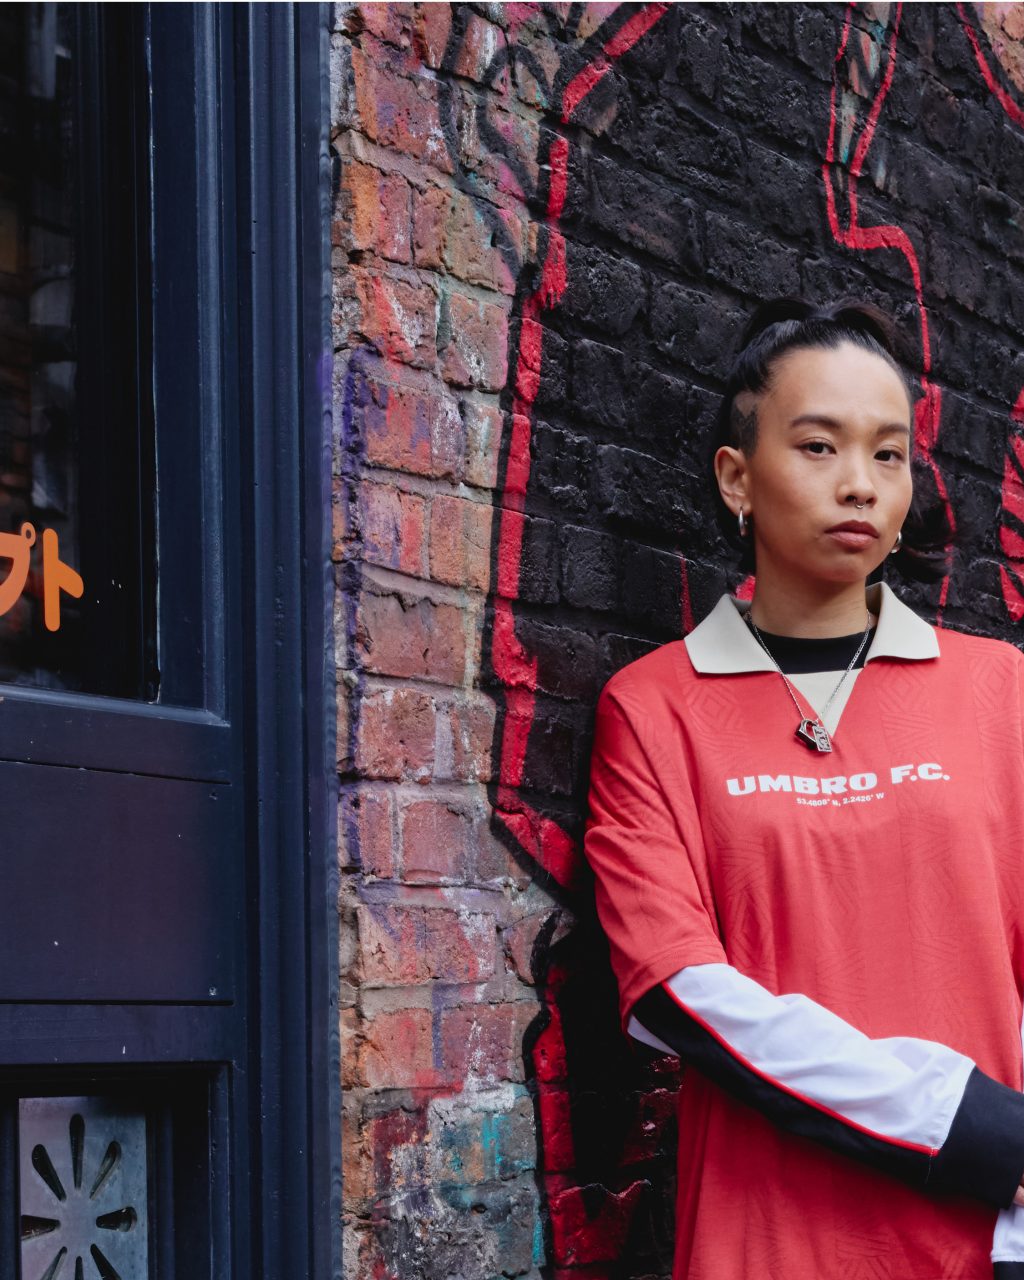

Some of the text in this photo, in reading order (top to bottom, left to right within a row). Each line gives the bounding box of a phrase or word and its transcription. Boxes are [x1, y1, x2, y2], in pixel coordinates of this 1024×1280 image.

[726, 762, 951, 796] UMBRO F.C.
[875, 792, 885, 800] W
